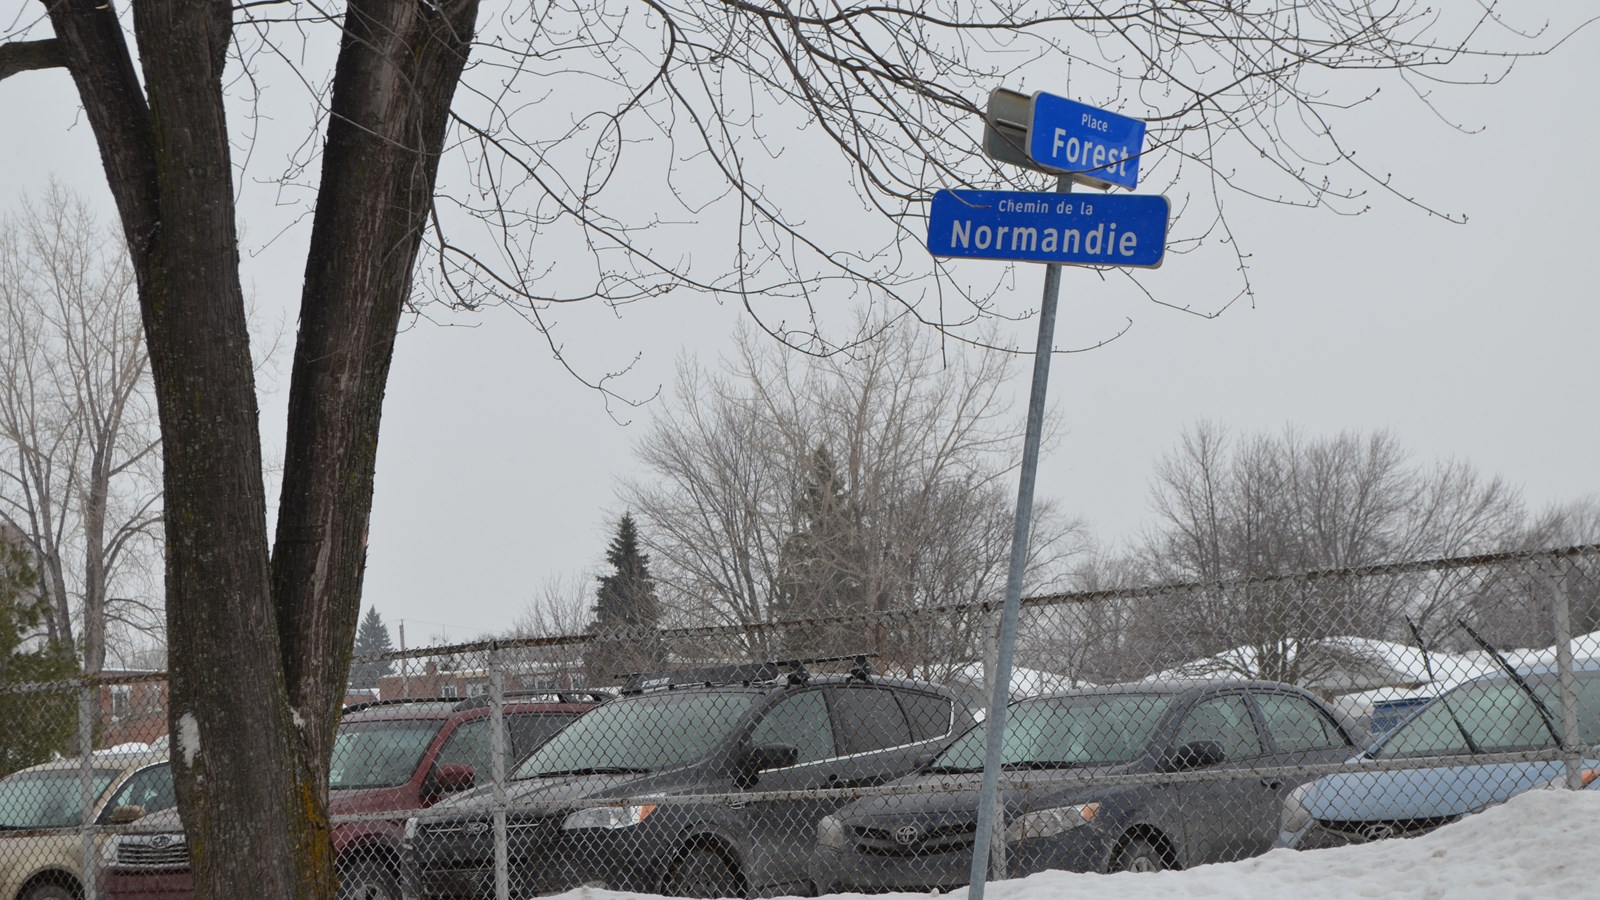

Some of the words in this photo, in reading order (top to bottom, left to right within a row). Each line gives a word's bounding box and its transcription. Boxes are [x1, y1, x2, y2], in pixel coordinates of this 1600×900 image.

[1081, 113, 1108, 132] Place
[1052, 127, 1128, 177] Forest
[999, 200, 1048, 213] Chemin
[1056, 201, 1073, 214] de
[1080, 202, 1093, 215] la
[951, 220, 1137, 256] Normandie
